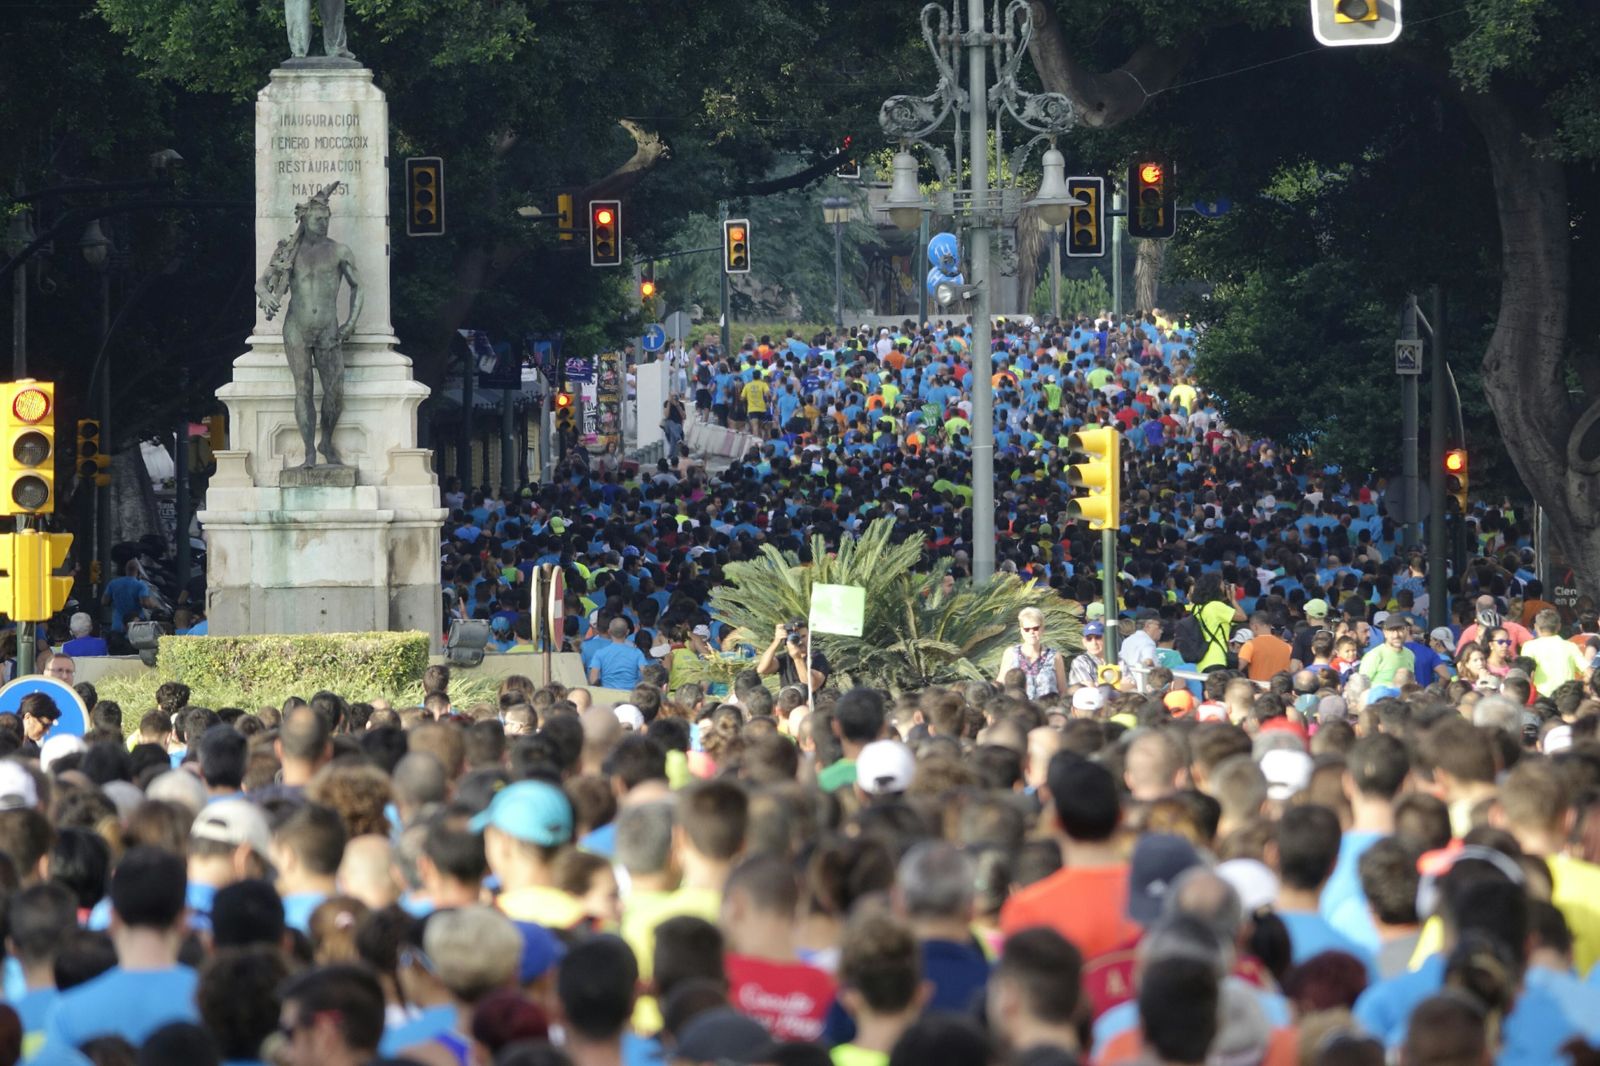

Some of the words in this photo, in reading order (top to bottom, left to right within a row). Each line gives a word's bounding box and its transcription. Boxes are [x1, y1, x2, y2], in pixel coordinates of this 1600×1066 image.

[280, 114, 360, 127] INAUGURACION
[278, 137, 309, 149] ENERO
[315, 136, 368, 149] MDCCCXCIX
[278, 160, 361, 174] RESTAURACION
[292, 183, 322, 196] MAYO
[1569, 598, 1578, 608] p
